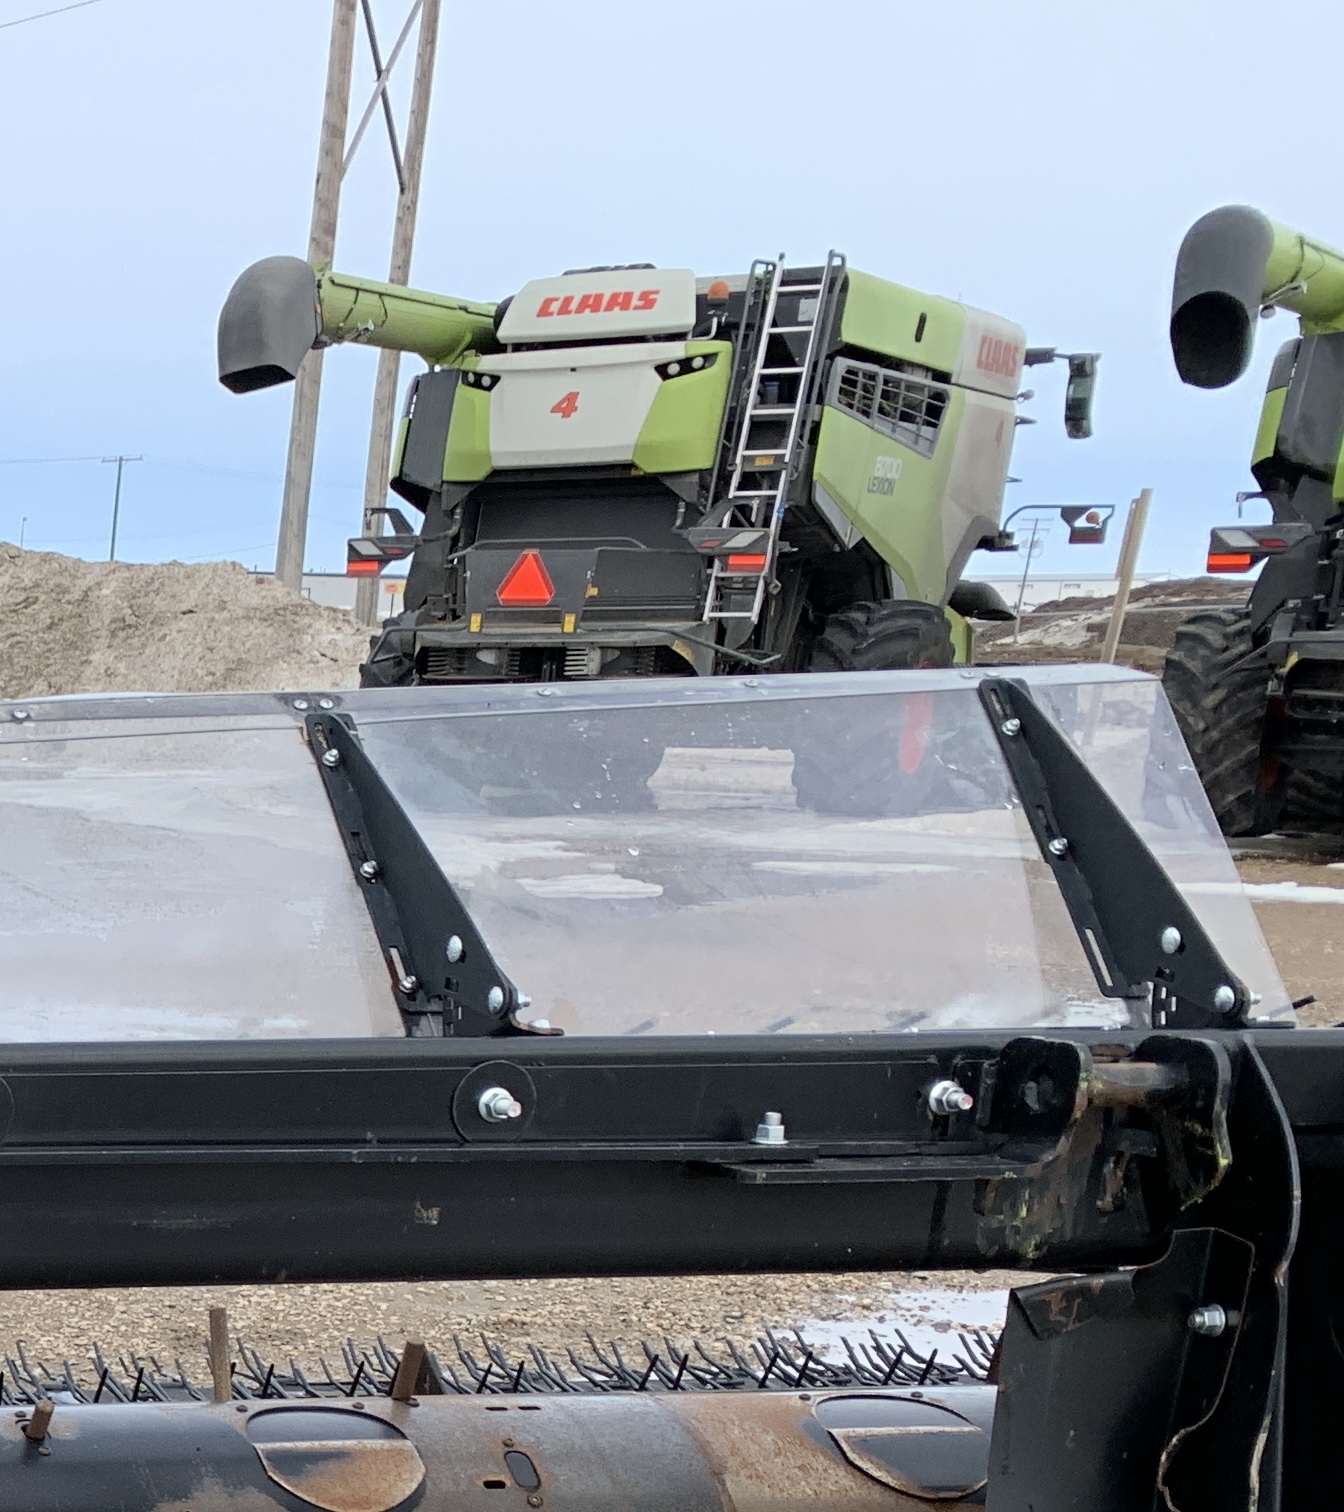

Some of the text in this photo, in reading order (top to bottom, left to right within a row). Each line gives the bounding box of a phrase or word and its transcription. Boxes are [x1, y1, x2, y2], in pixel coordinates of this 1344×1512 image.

[536, 289, 661, 318] CLAAS
[976, 334, 1021, 378] CLAAS
[550, 391, 580, 419] 4
